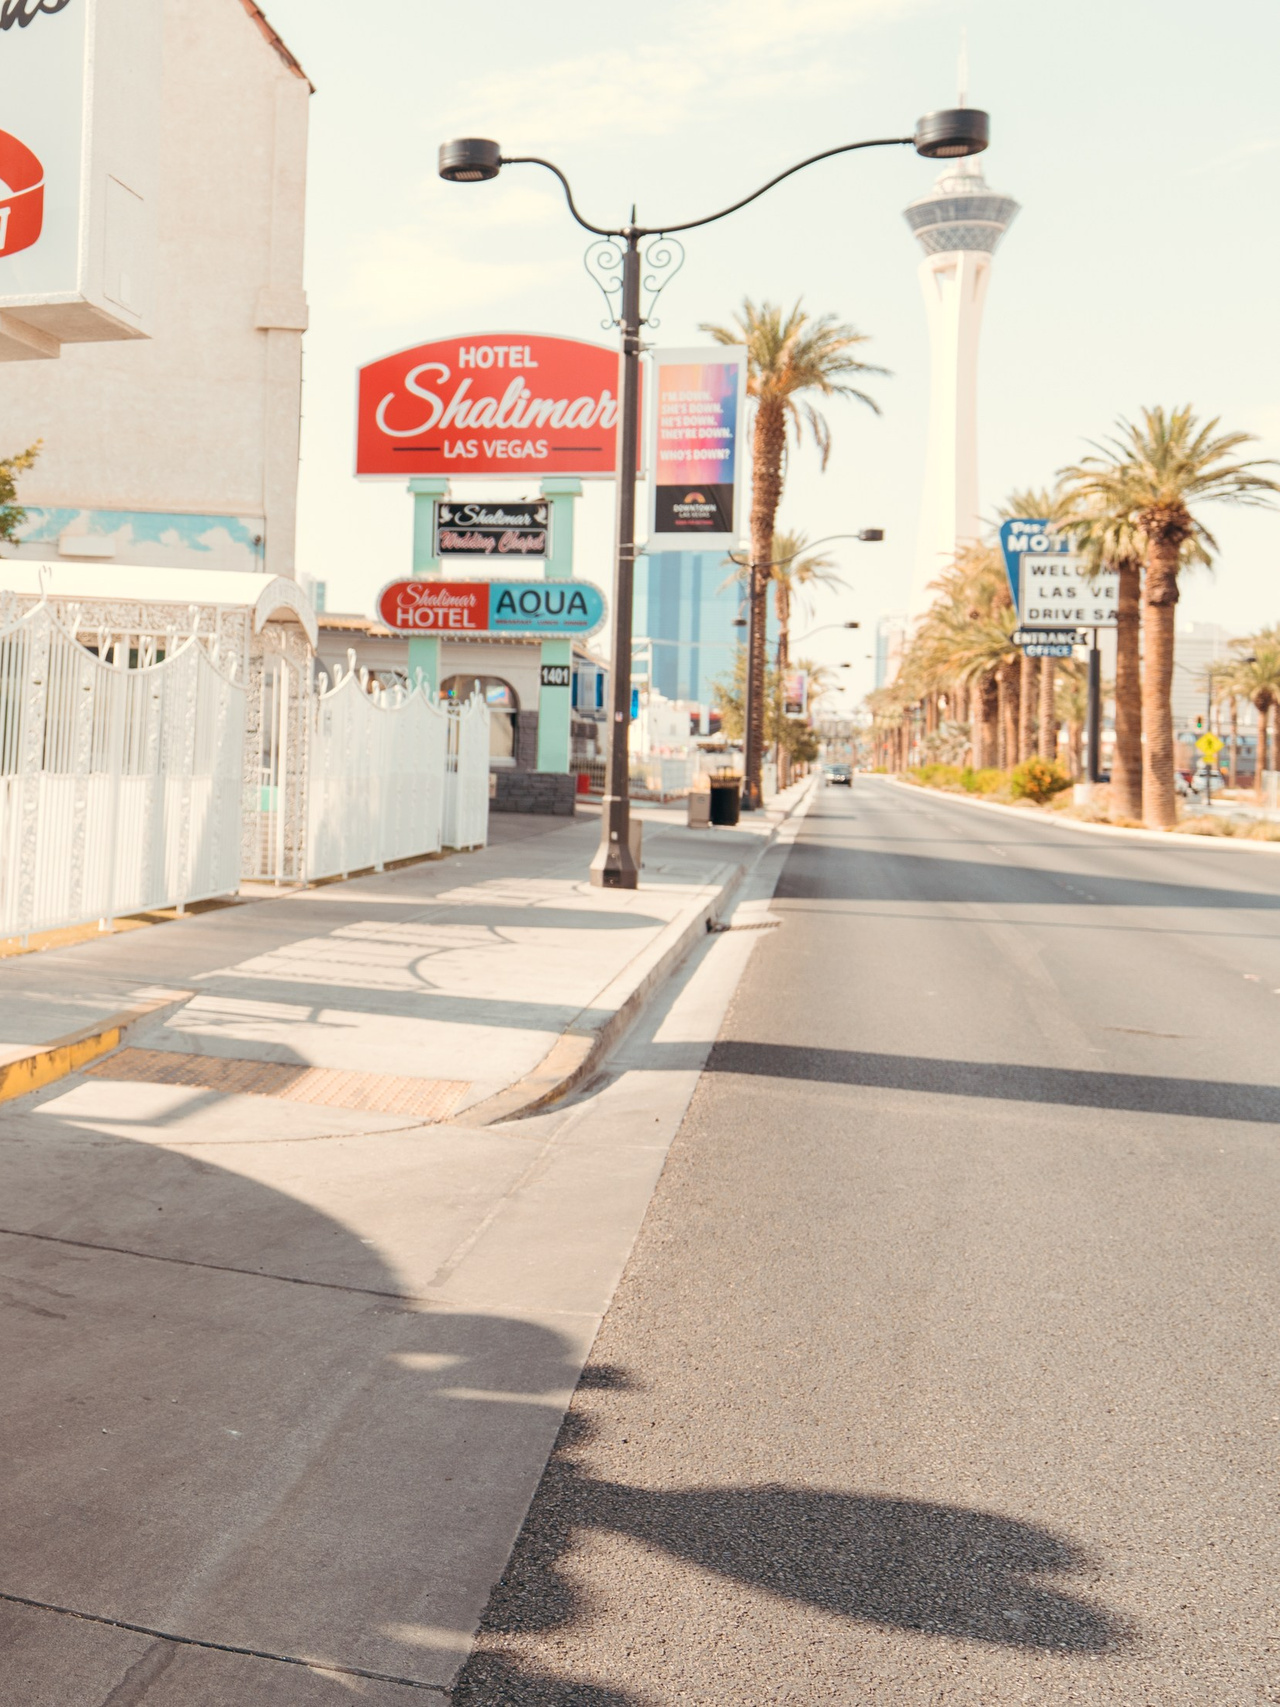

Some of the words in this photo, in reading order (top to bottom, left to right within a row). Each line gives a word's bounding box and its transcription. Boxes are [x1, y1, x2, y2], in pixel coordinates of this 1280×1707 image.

[459, 346, 538, 368] HOTEL
[375, 362, 620, 438] Shalimar
[661, 403, 687, 414] SHE'S
[661, 416, 681, 427] HE'S
[661, 427, 697, 439] THEY'RE
[444, 440, 478, 459] LAS
[483, 439, 548, 458] VEGAS
[660, 449, 692, 461] WHO'S
[693, 448, 731, 460] DOWN?
[454, 504, 531, 526] Shalimar
[397, 583, 477, 608] Shalimar
[1038, 586, 1078, 598] LAS
[496, 590, 588, 617] AQUA
[396, 607, 477, 629] HOTEL
[1028, 608, 1085, 620] DRIVE
[1013, 631, 1083, 645] ENTRANCE
[542, 667, 570, 685] 1401
